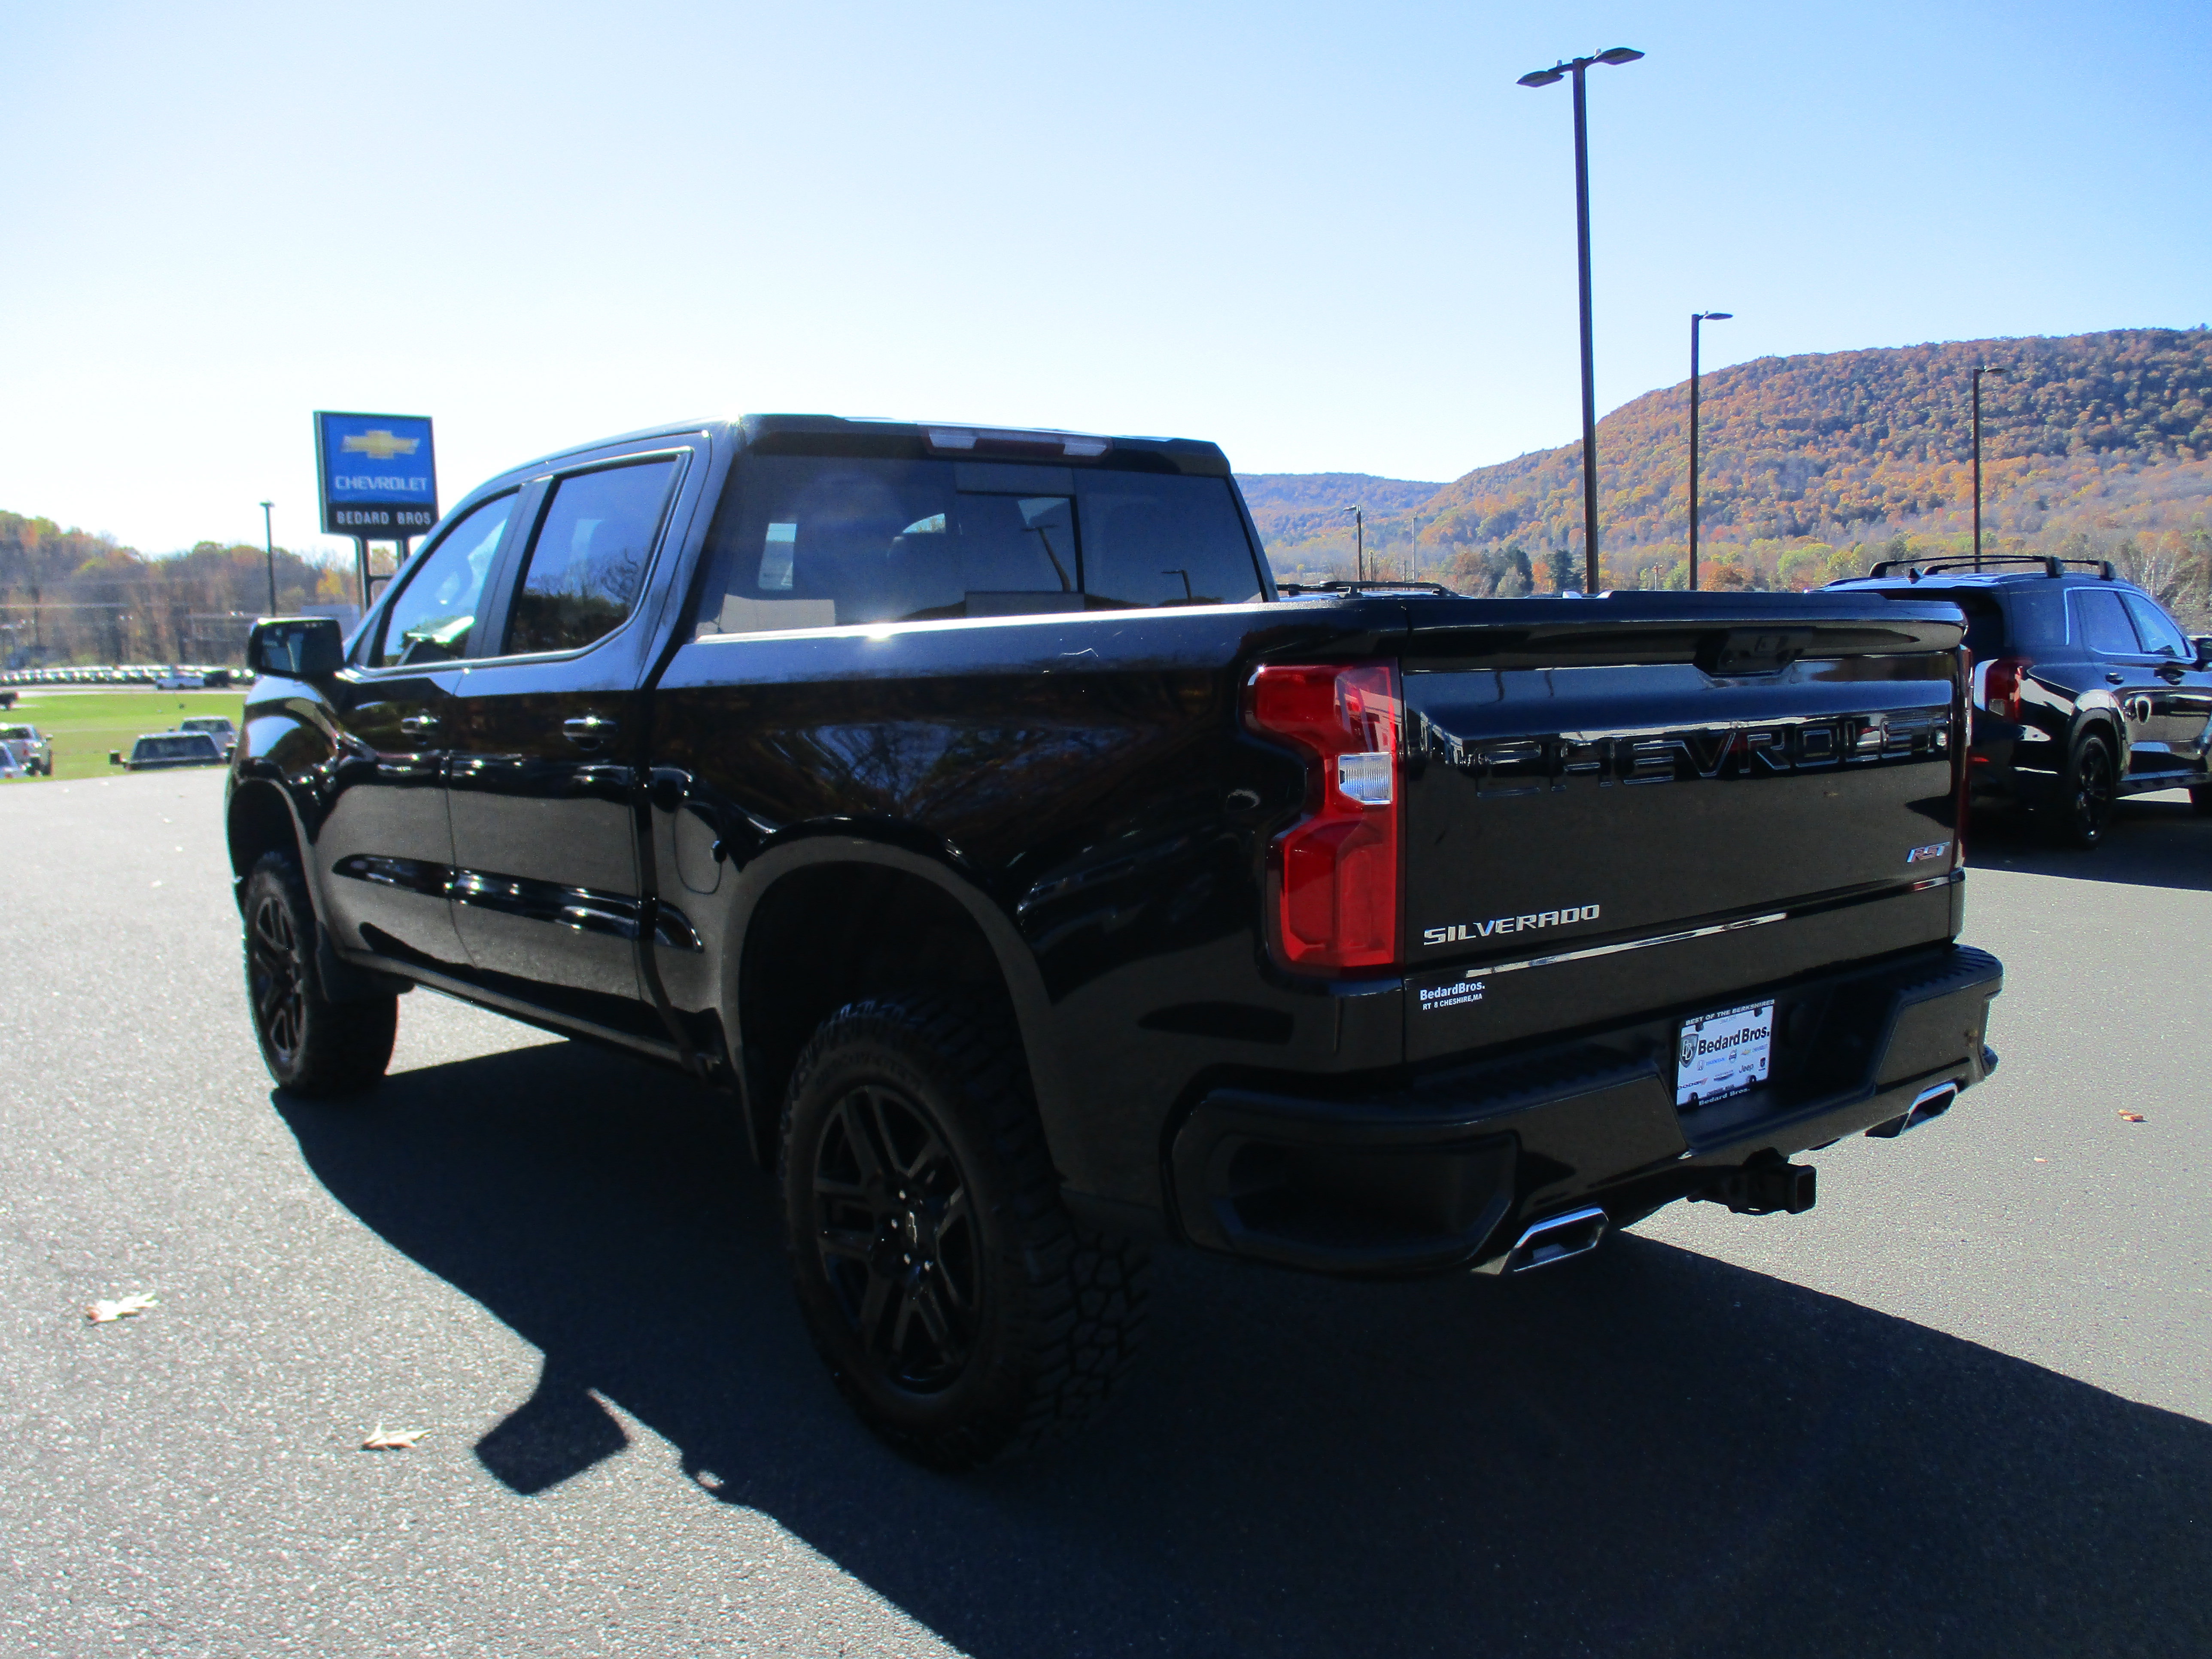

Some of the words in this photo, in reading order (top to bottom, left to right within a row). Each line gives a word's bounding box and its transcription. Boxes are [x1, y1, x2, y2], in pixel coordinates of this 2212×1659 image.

[335, 476, 428, 491] CHEVROLET
[337, 510, 390, 525] BEDARD
[396, 511, 431, 525] BROS
[1906, 842, 1951, 863] RST
[1424, 904, 1600, 945] SILVERADO
[1685, 1016, 1704, 1026] BEST
[1732, 999, 1775, 1014] BERKSHIRES
[1738, 1063, 1754, 1073] Jeep
[1698, 1092, 1728, 1106] Bedard
[1730, 1088, 1750, 1097] Bros.
